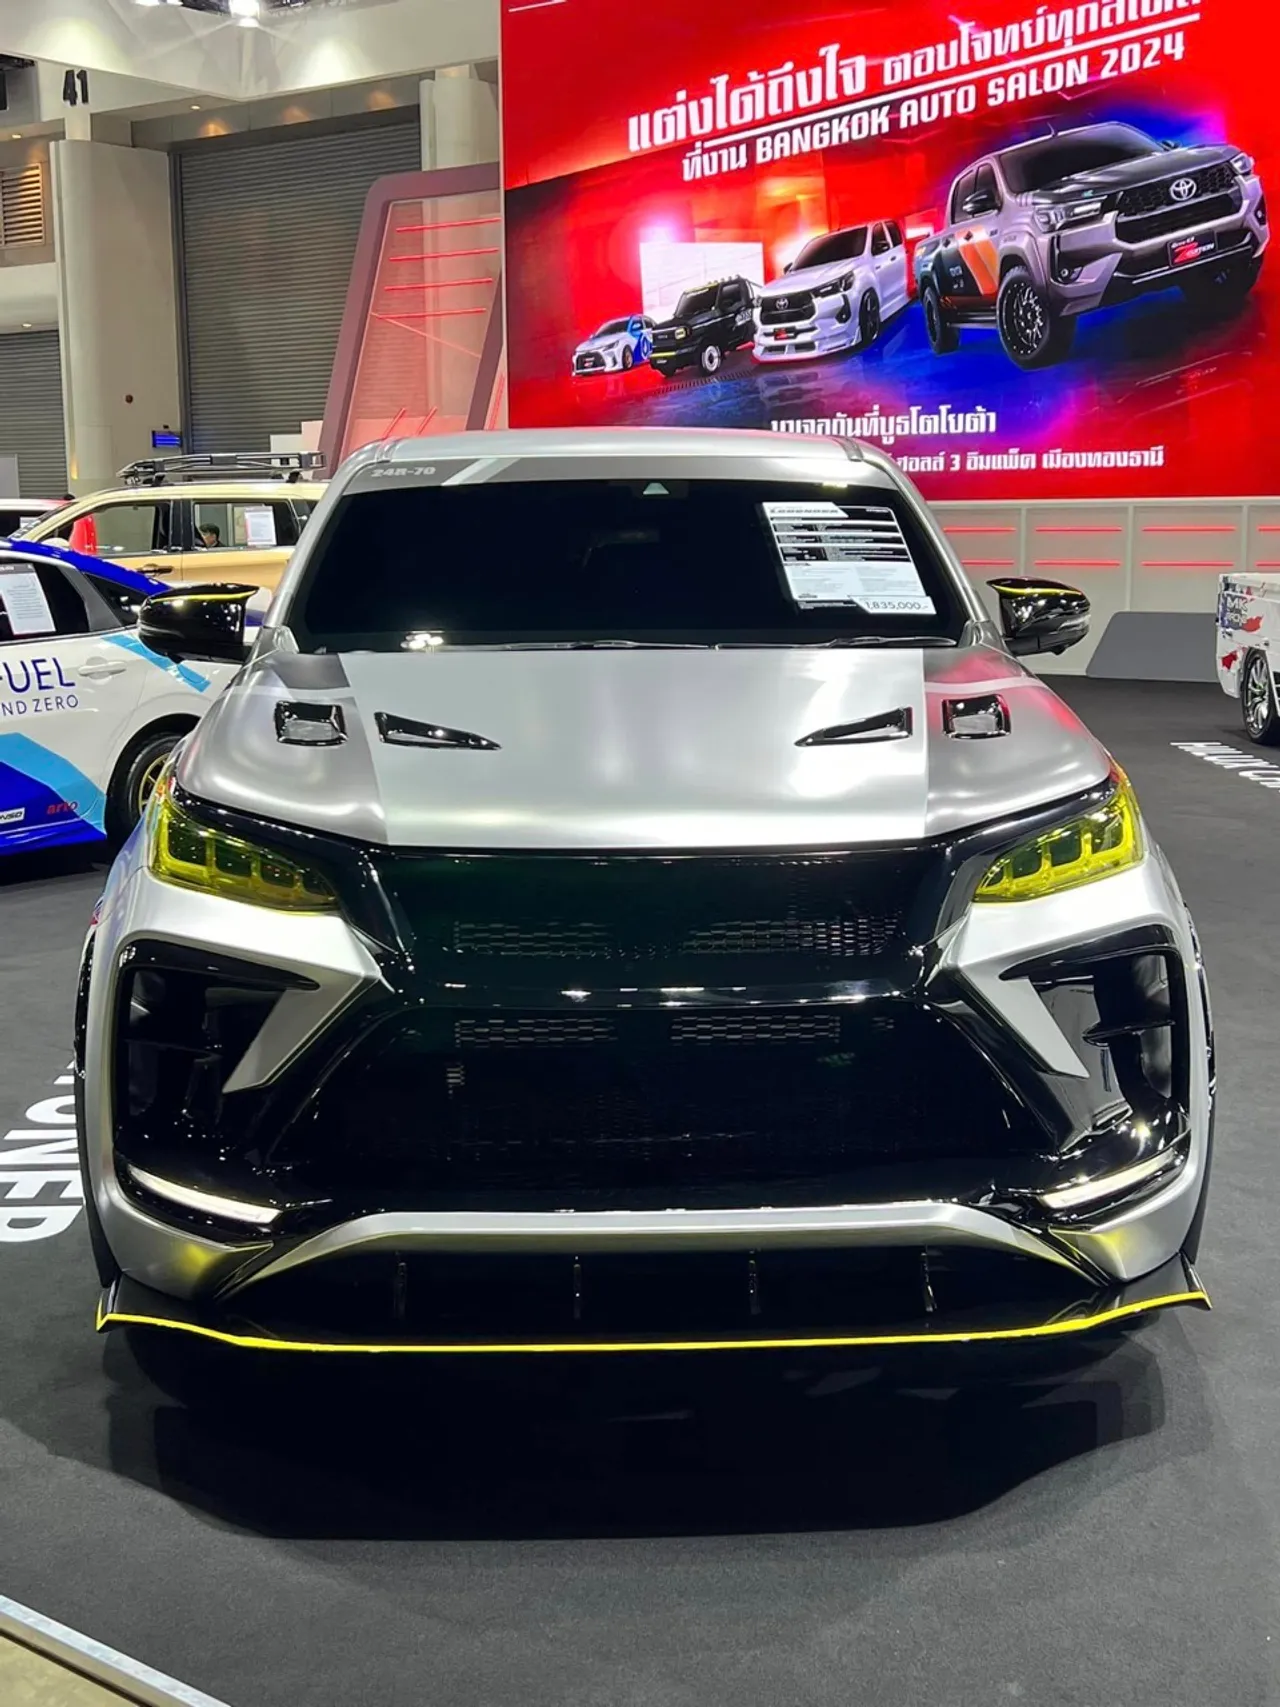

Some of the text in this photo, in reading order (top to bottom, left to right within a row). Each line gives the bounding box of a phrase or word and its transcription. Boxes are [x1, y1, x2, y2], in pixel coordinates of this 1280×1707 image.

[63, 69, 88, 106] 41
[628, 43, 866, 152] แต่งได้ถึงใจ
[682, 31, 1184, 181] ที่งาน BANGKOK AUTO SALON 2024
[950, 456, 960, 471] 3
[1042, 446, 1163, 468] เมืองทองธานี
[0, 657, 76, 693] UEL
[32, 694, 79, 713] ZERO
